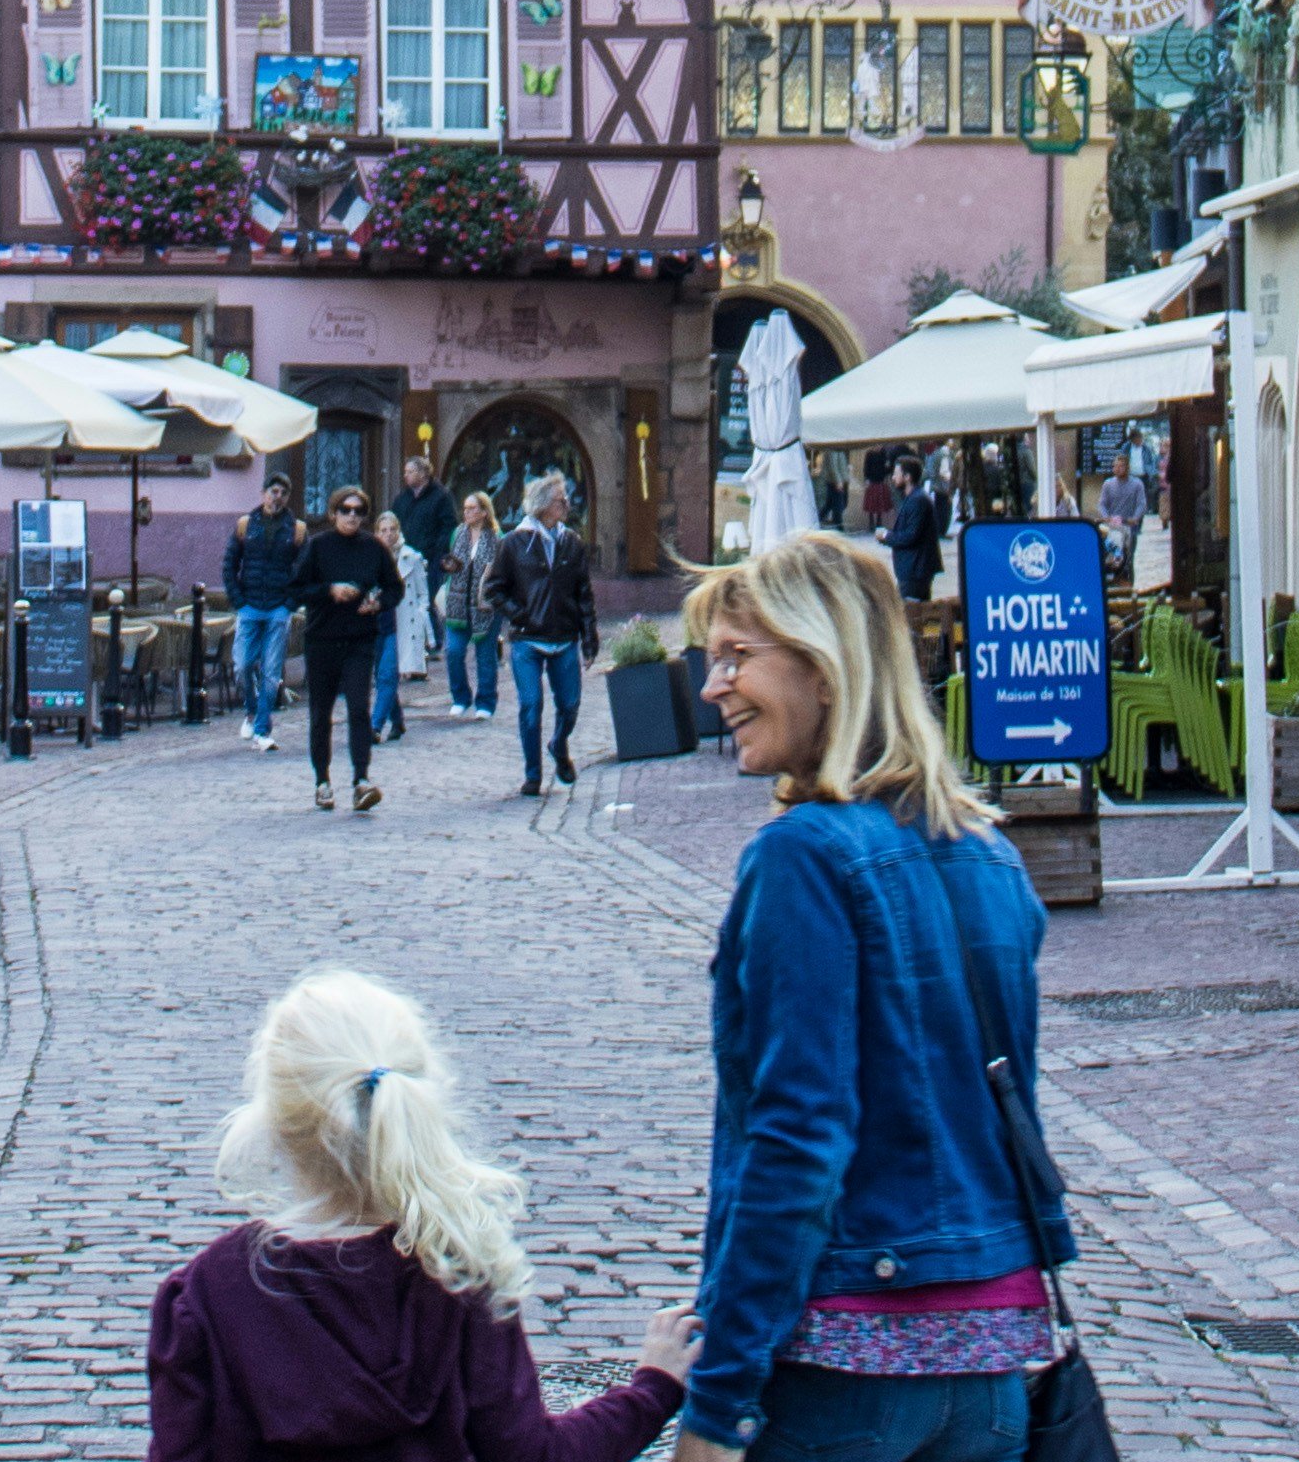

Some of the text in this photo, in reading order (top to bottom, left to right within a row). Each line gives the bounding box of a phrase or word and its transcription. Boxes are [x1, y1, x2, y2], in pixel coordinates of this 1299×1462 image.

[986, 593, 1069, 632] HOTEL
[975, 638, 1100, 680] ST MARTIN
[996, 688, 1037, 703] Maison
[1040, 686, 1054, 702] de
